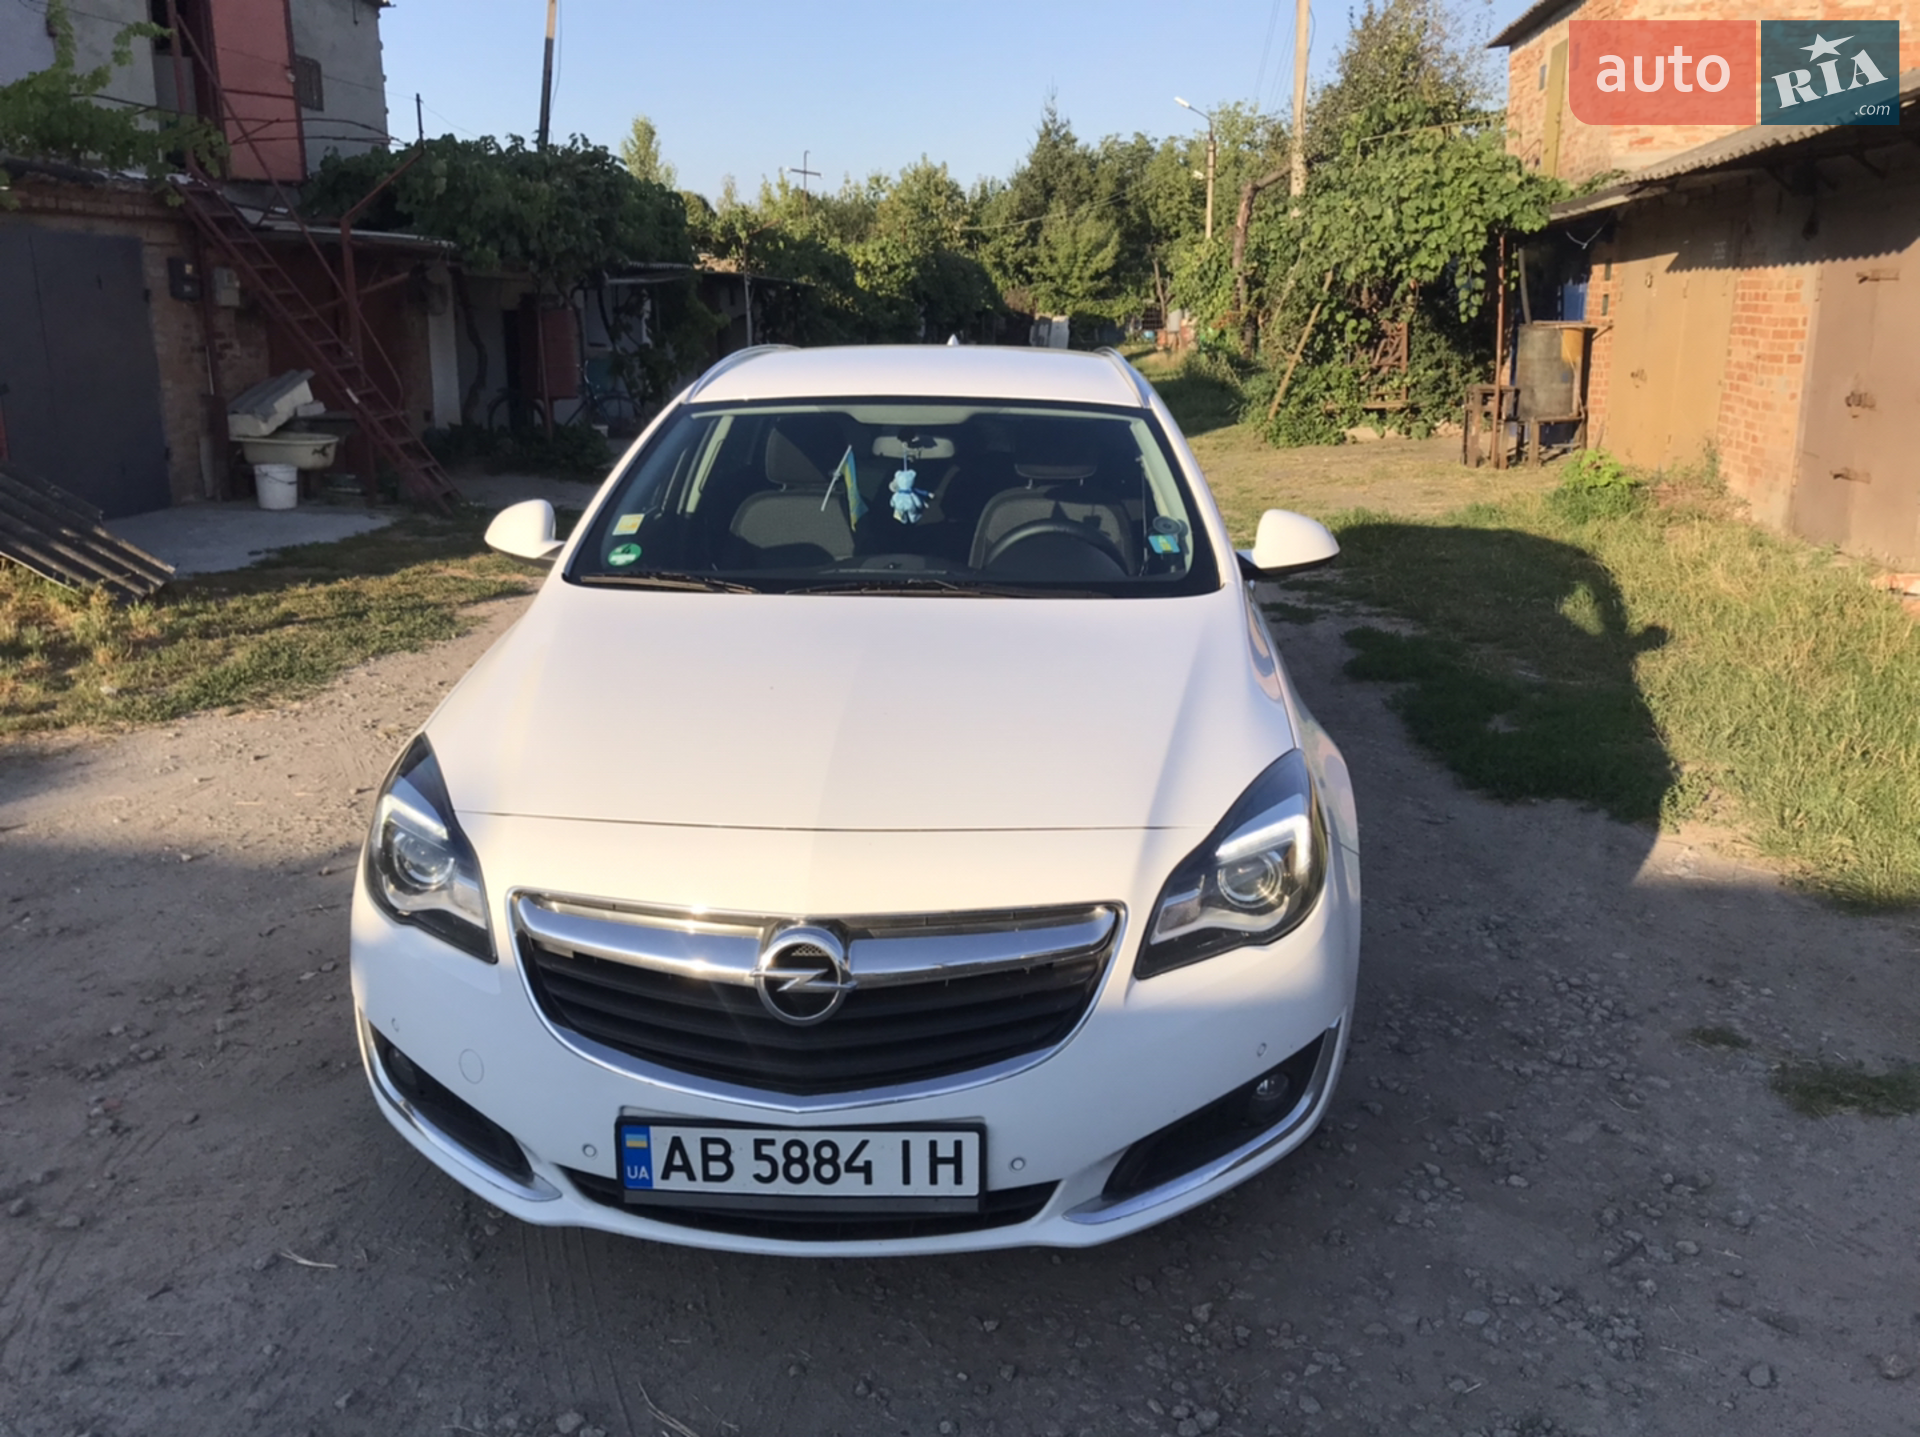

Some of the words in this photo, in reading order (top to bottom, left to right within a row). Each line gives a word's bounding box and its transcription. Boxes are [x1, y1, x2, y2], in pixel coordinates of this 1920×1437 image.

[627, 1166, 650, 1181] UA
[660, 1136, 735, 1183] AB
[752, 1138, 873, 1185] 5884
[901, 1139, 963, 1185] IH
